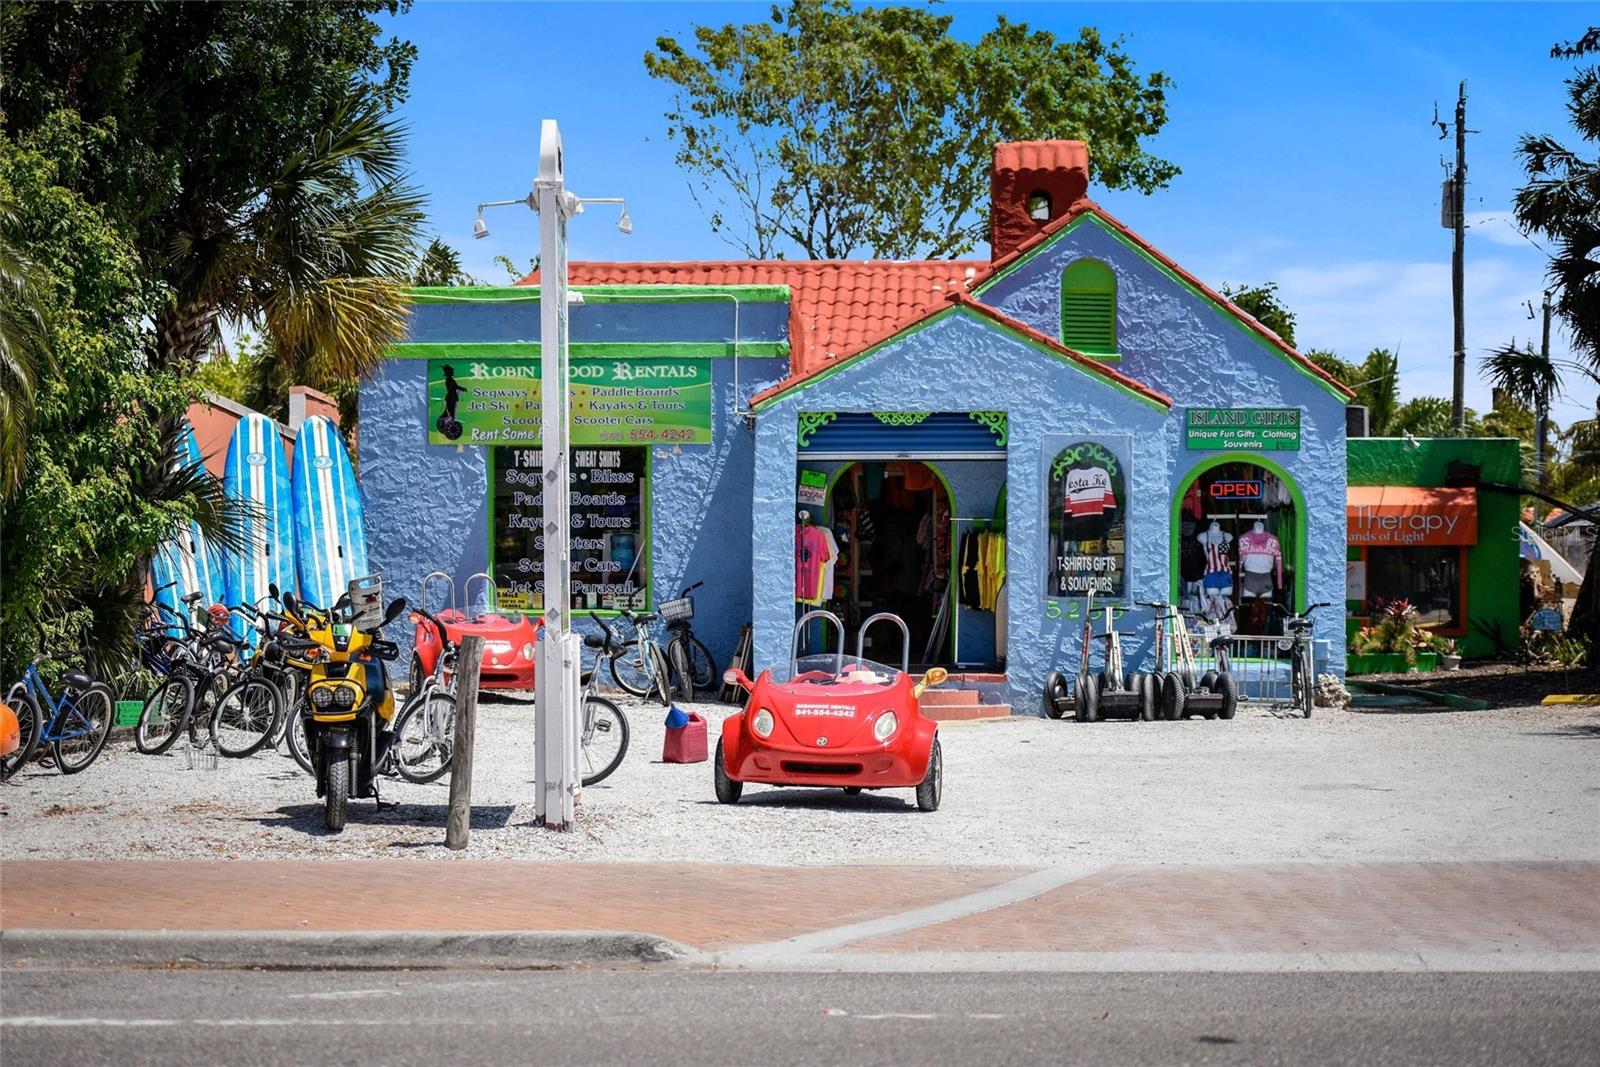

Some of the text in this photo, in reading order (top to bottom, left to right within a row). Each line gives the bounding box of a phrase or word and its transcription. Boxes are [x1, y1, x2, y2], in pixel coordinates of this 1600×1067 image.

[611, 361, 698, 381] RENTALS
[473, 387, 528, 398] Segways
[467, 400, 685, 413] Jet Ski Kayaks & Tours
[503, 415, 654, 425] Scoote Scooter Cars
[1189, 410, 1297, 426] ISLAND GIFTS
[471, 428, 499, 441] Rent
[502, 427, 535, 441] Some
[630, 428, 695, 441] 554-4242
[1188, 430, 1297, 440] Unique Fun Gifts Clothing
[1223, 440, 1263, 448] Souvenirs
[514, 450, 621, 468] T-SHIR SWEAT SHIRTS
[590, 469, 635, 483] Bikes
[1209, 483, 1259, 496] OPEN
[514, 491, 626, 506] Pad Boards
[570, 514, 585, 528] &
[587, 513, 632, 529] Tours
[1354, 504, 1458, 536] Therapy
[1348, 530, 1425, 545] ands of Light
[584, 557, 622, 573] Cars
[1057, 556, 1116, 572] T-SHIRTS GIFTS
[507, 580, 532, 595] Jet
[572, 579, 634, 595] Parasail
[1060, 576, 1113, 592] & SOUVENIRS
